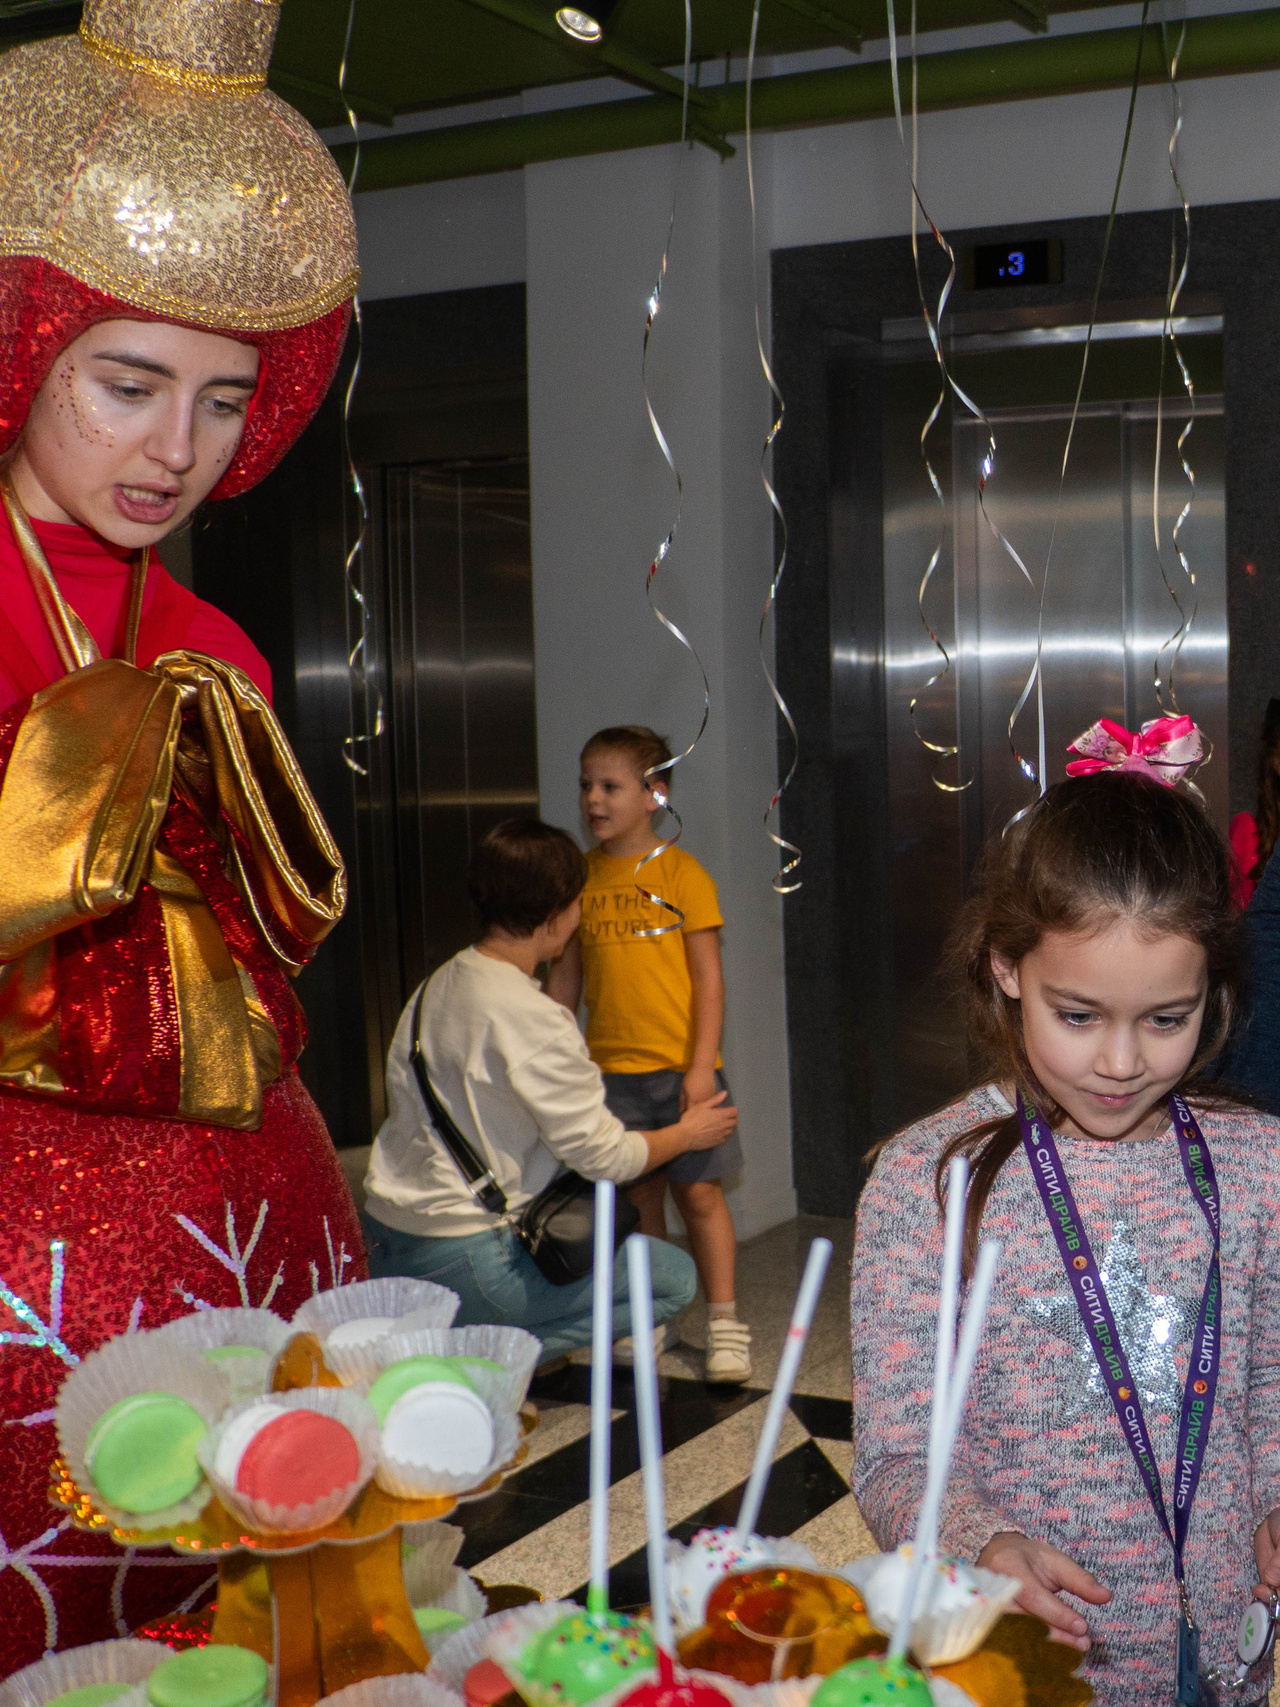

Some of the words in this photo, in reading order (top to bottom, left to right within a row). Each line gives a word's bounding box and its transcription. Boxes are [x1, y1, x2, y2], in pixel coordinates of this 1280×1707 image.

[613, 893, 651, 911] THE
[1036, 1148, 1081, 1251] СИТИДРАЙВ
[1080, 1275, 1124, 1380] СИТИДРАЙВ
[1177, 1400, 1205, 1509] СИТИДРАЙВ
